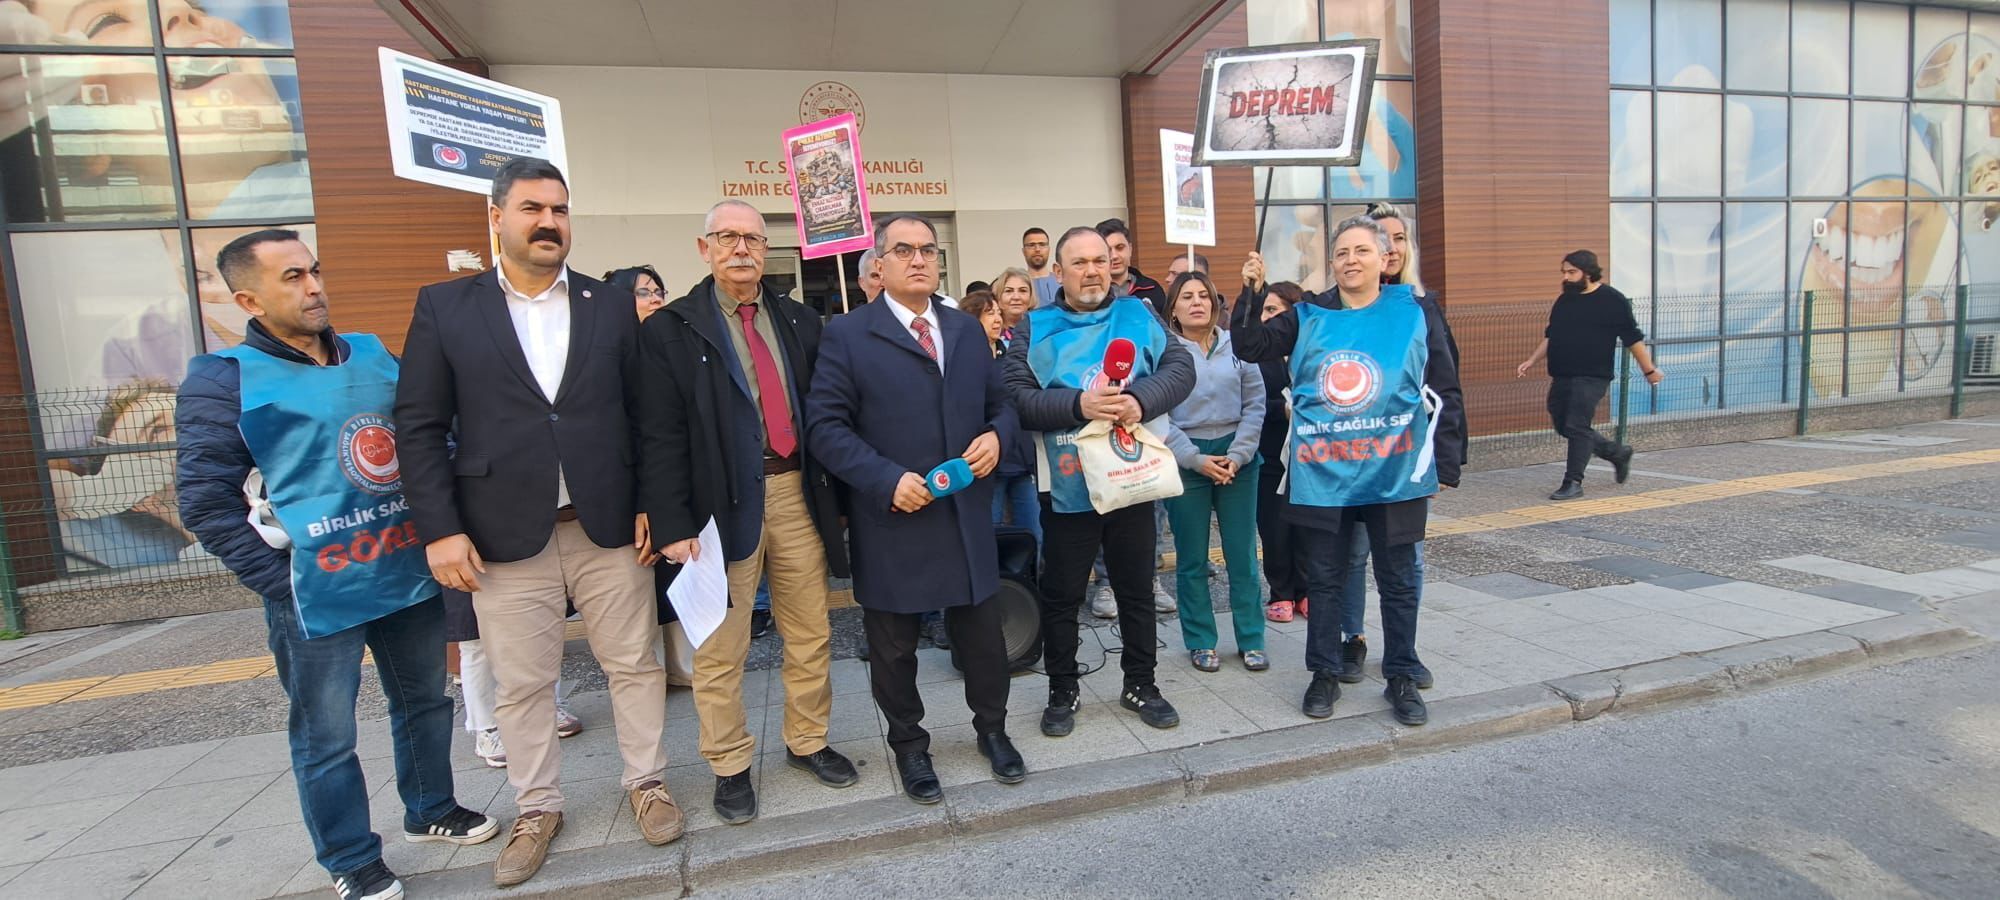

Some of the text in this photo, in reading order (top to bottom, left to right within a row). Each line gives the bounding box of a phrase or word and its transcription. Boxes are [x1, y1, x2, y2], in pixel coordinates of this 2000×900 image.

[428, 92, 458, 107] HASTANE
[459, 101, 481, 112] YOKSA
[1228, 85, 1334, 118] DEPREM
[745, 160, 774, 174] T.C.
[862, 158, 923, 174] KANLIĞI
[722, 180, 770, 196] İZMİR
[774, 180, 793, 196] EĞ
[350, 416, 384, 430] BİRLİK
[1296, 420, 1330, 436] BİRLİK
[1333, 416, 1387, 432] SAĞLIK
[307, 507, 376, 538] BİRLİK
[316, 520, 420, 572] GÖRE
